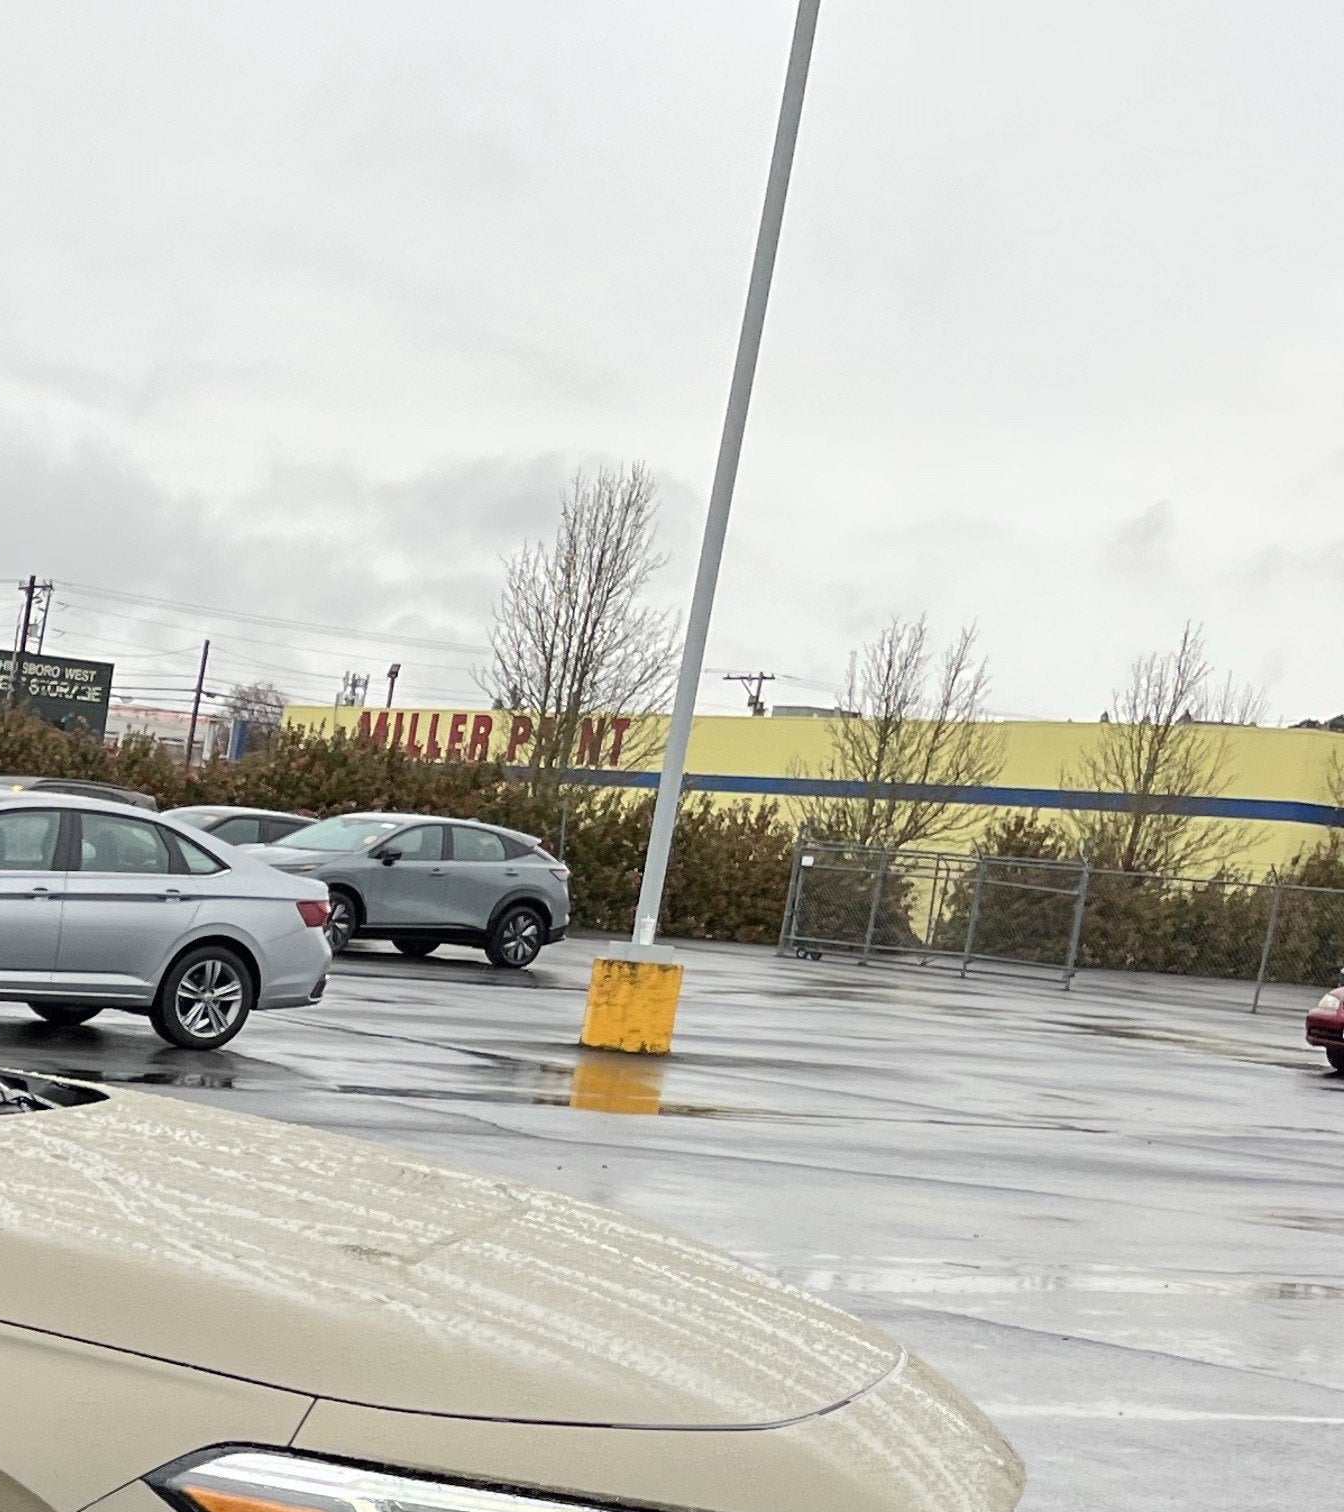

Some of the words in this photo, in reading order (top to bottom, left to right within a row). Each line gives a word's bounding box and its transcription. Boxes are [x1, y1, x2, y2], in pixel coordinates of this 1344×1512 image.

[64, 668, 96, 682] WEST
[357, 711, 493, 761] MILLER
[507, 715, 631, 767] PNT
